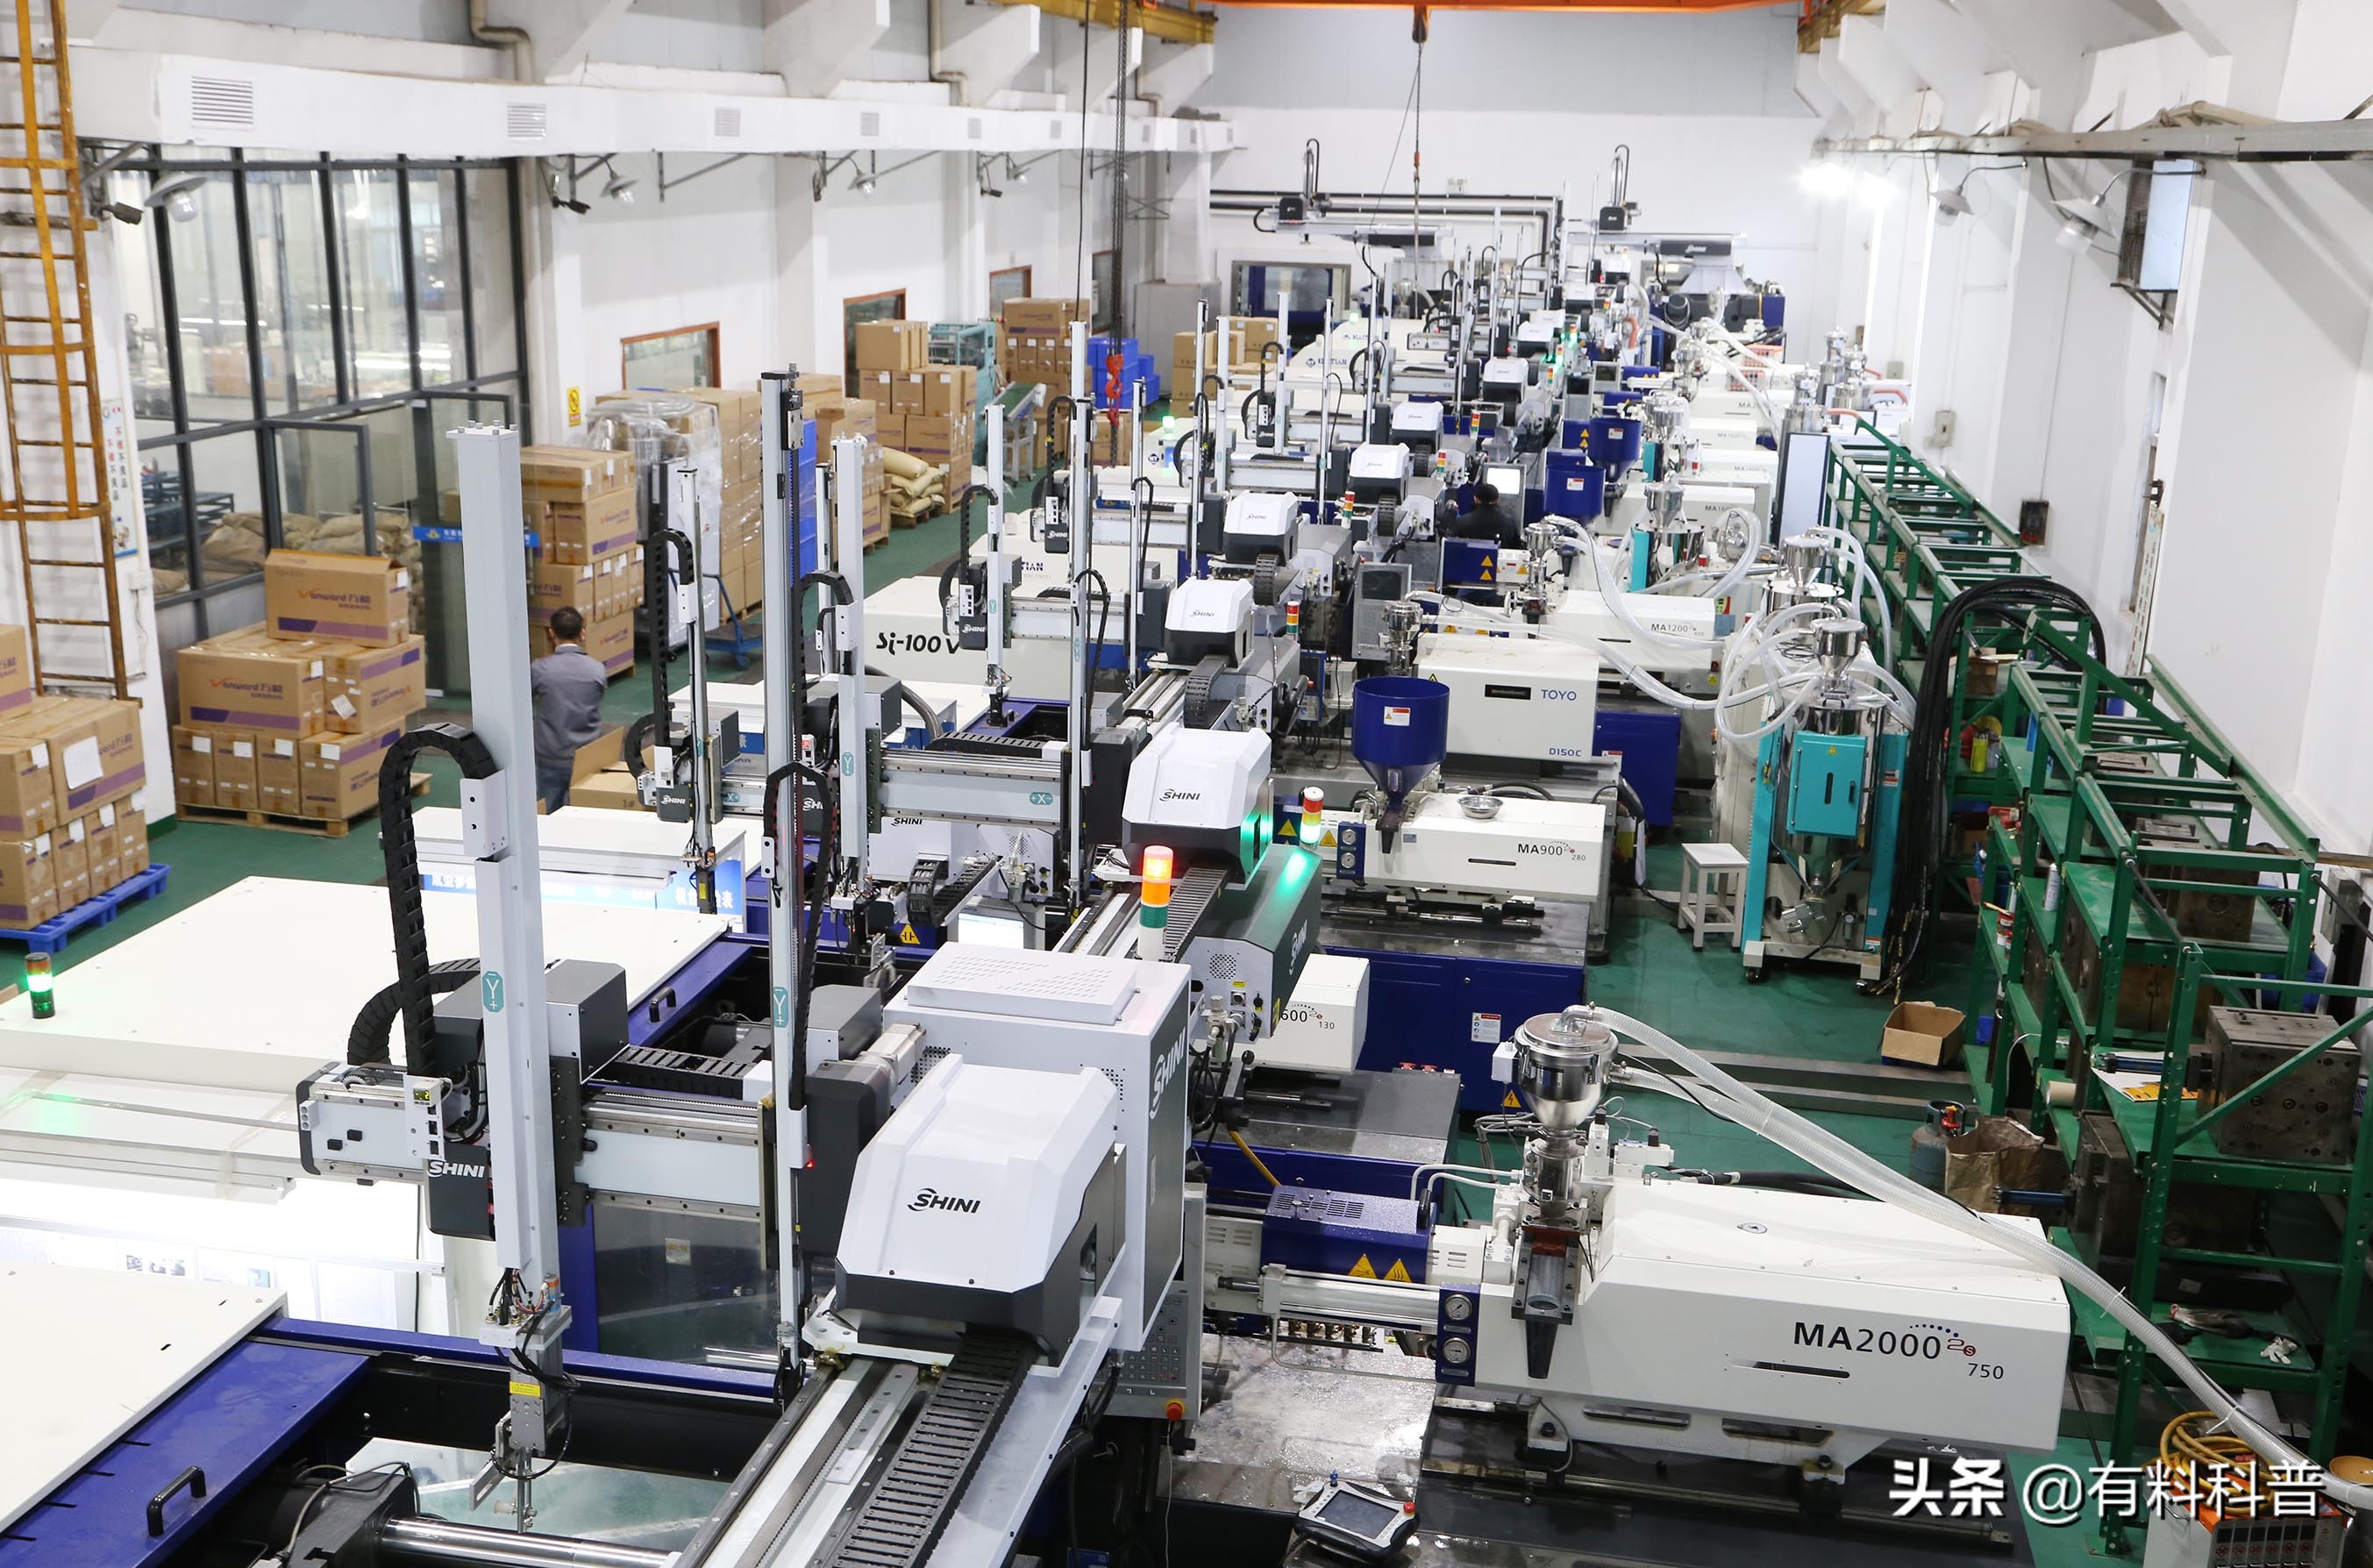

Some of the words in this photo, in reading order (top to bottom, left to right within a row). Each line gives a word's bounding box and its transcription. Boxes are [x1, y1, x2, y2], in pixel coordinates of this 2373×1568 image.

[1192, 609, 1215, 617] SHINI
[1651, 624, 1688, 632] MA1200
[1541, 688, 1577, 702] TOYO
[660, 795, 686, 805] SHINI
[1159, 788, 1201, 802] SHINI
[892, 817, 923, 827] SHINI
[1518, 843, 1563, 856] MA900
[1319, 1021, 1335, 1030] 130
[1150, 1027, 1186, 1120] SHINI
[427, 1160, 485, 1179] SHINI
[907, 1187, 980, 1214] SHINI
[1793, 1322, 1941, 1359] MA2000
[1967, 1363, 2005, 1380] 750
